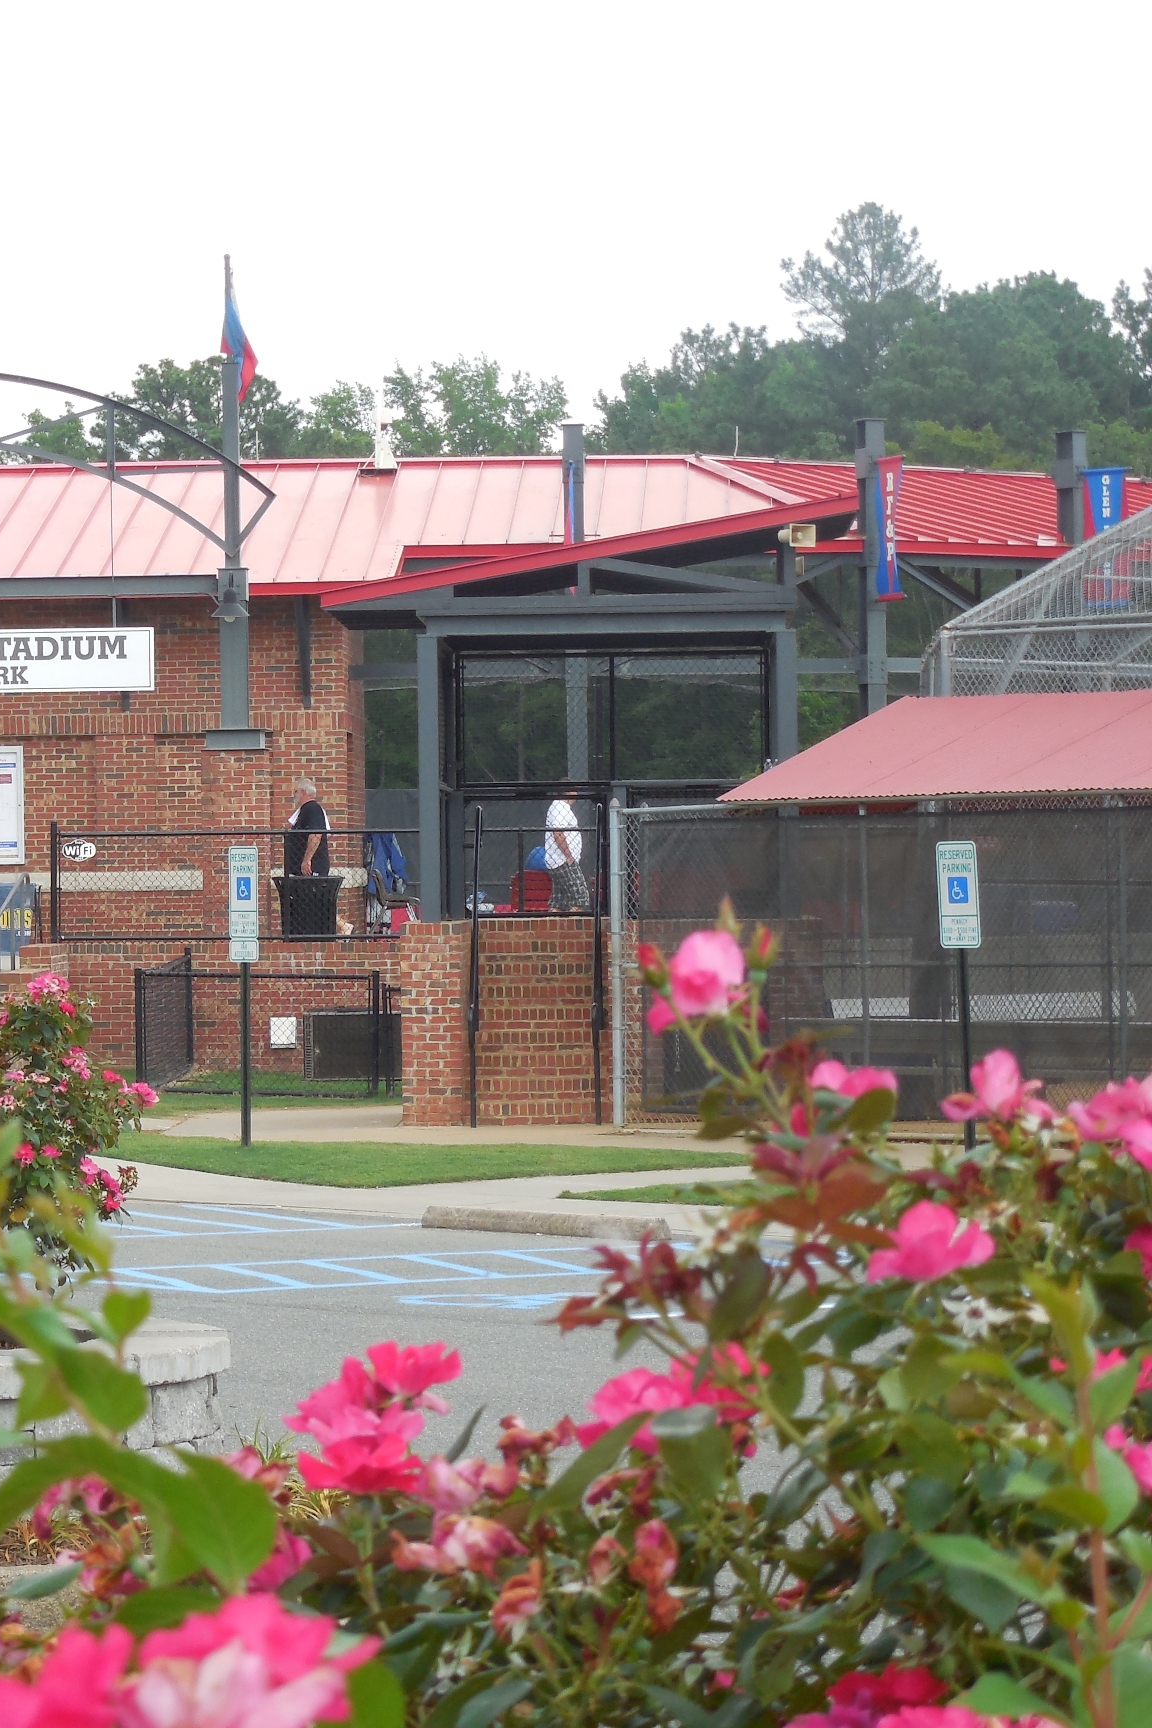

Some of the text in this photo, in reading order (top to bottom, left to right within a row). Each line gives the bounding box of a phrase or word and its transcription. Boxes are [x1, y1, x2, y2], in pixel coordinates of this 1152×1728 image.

[1101, 475, 1111, 518] GLEN
[886, 472, 894, 562] RF&P
[231, 854, 256, 862] RESERVED
[940, 849, 973, 860] RESERVED
[233, 865, 254, 873] PARKING
[942, 863, 972, 873] PARKING
